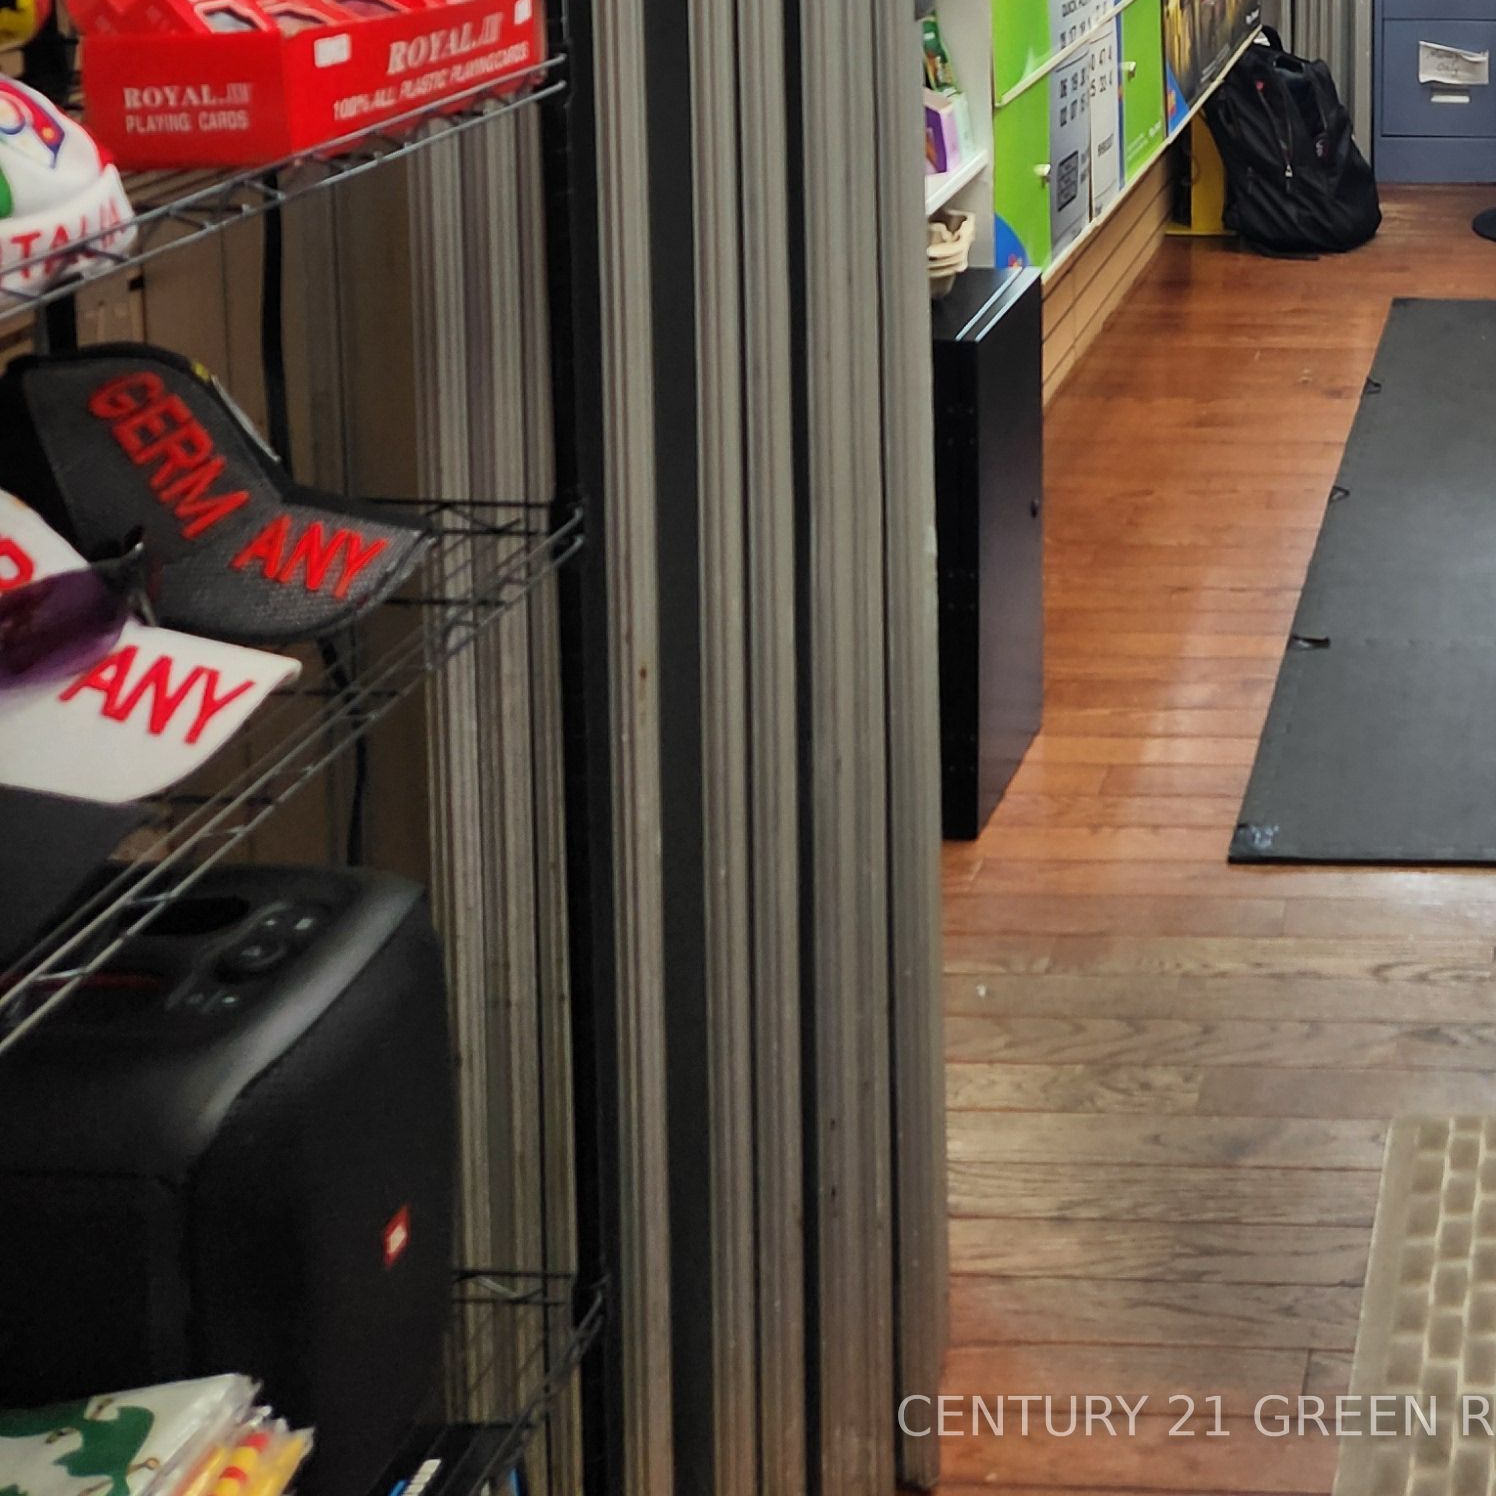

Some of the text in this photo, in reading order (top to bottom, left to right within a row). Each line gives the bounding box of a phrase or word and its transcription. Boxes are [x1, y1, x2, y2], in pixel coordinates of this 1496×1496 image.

[387, 21, 474, 76] ROYAL
[123, 83, 214, 109] ROYAL
[126, 110, 250, 134] PLAYING CARDS
[0, 196, 126, 280] TALIA
[88, 370, 391, 600] GERM ANY
[58, 644, 257, 746] ANY
